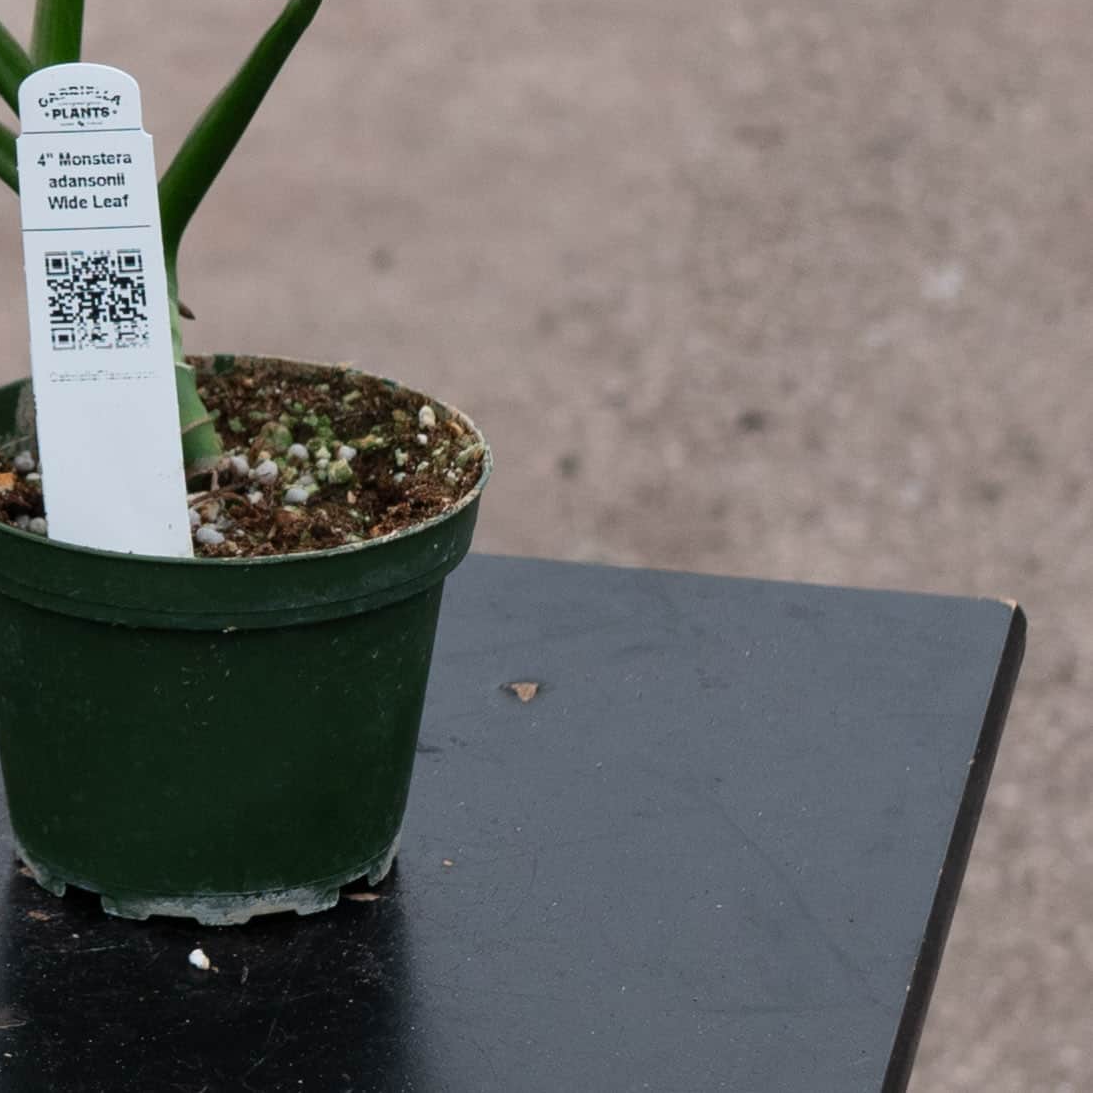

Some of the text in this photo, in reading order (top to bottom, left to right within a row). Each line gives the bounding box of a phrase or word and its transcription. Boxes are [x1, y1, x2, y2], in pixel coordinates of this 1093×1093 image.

[52, 107, 110, 119] PLANTS
[37, 152, 132, 166] 4" Monstera
[49, 173, 125, 188] adansonii
[48, 194, 129, 210] Wide Leaf
